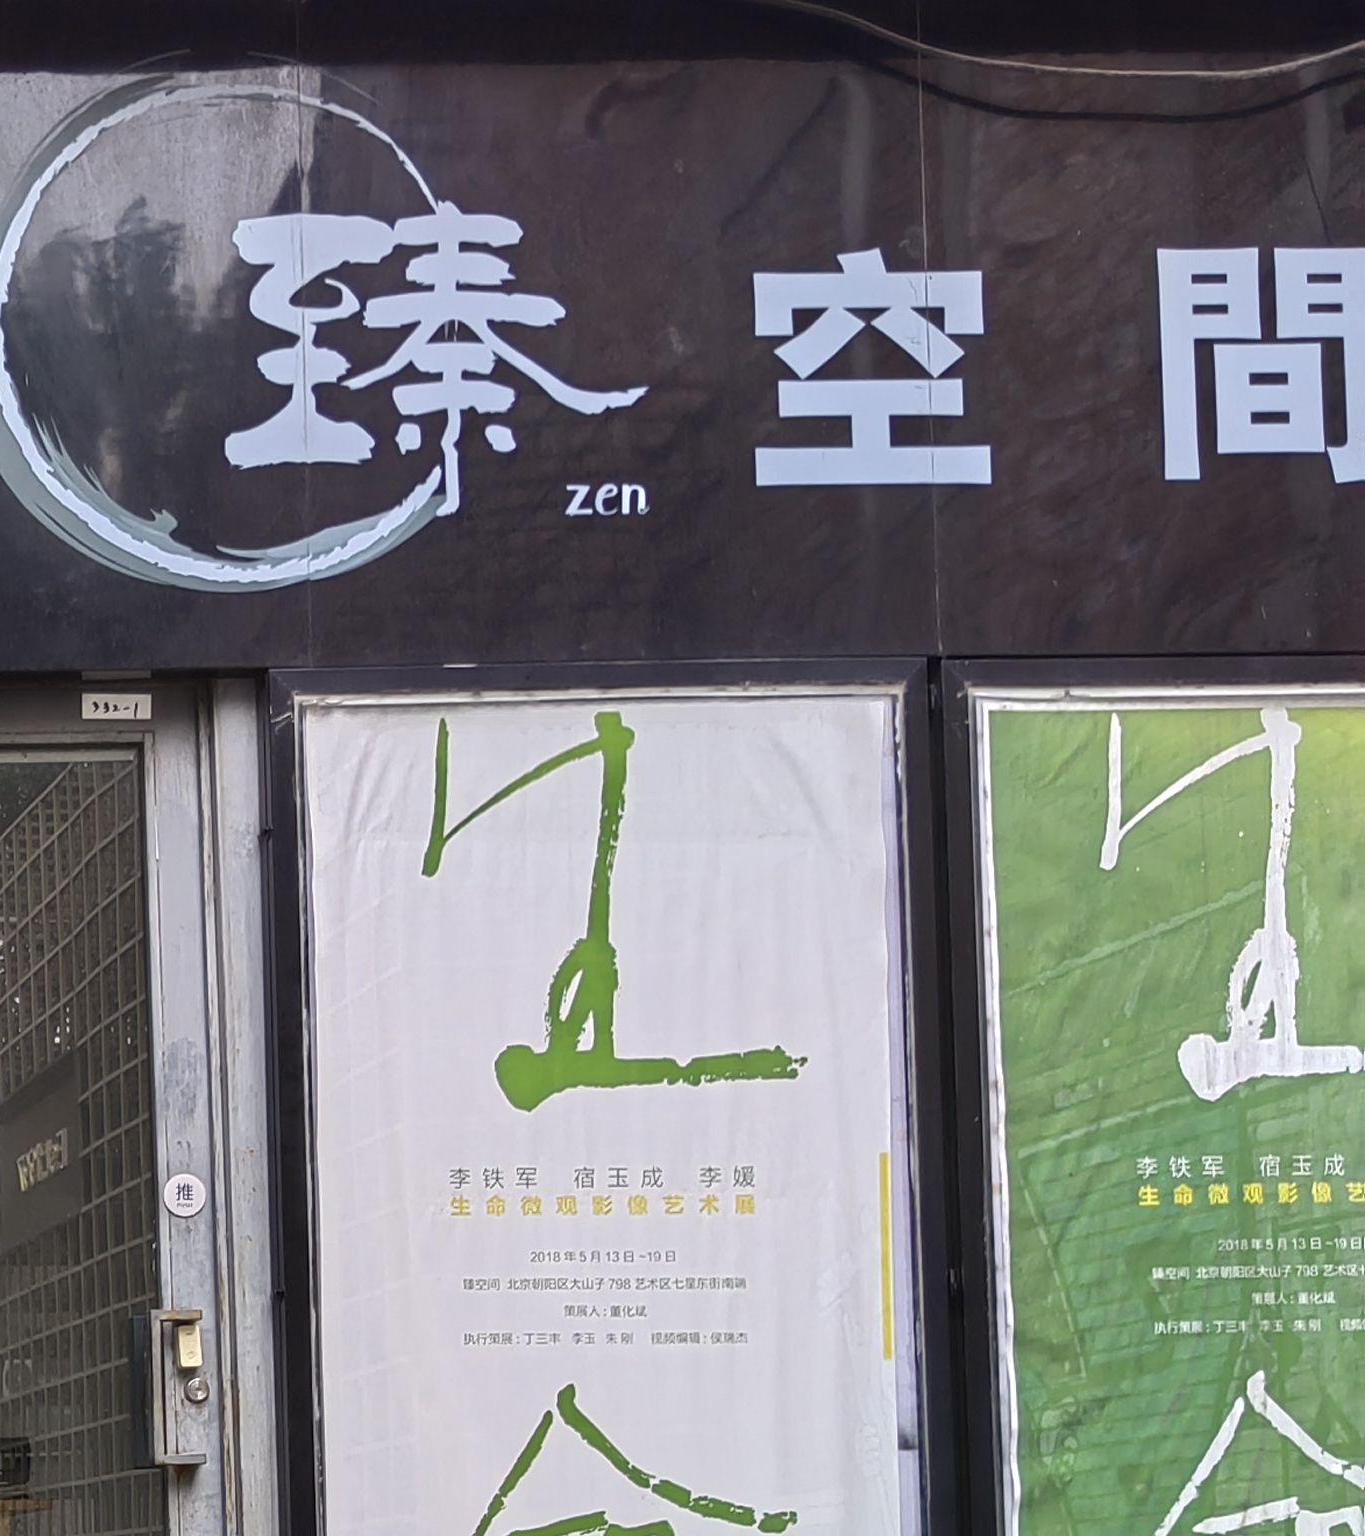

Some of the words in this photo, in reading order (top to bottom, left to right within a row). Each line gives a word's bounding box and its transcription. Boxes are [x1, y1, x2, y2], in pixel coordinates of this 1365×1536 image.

[565, 483, 650, 516] zen
[449, 1167, 538, 1189] 李铁军
[574, 1166, 663, 1189] 宿玉成
[699, 1165, 756, 1188] 李媛
[1136, 1155, 1225, 1179] 李铁军
[1259, 1153, 1345, 1177] 宿玉成
[176, 1183, 194, 1201] 推
[450, 1195, 756, 1216] 生命微观影像艺术展
